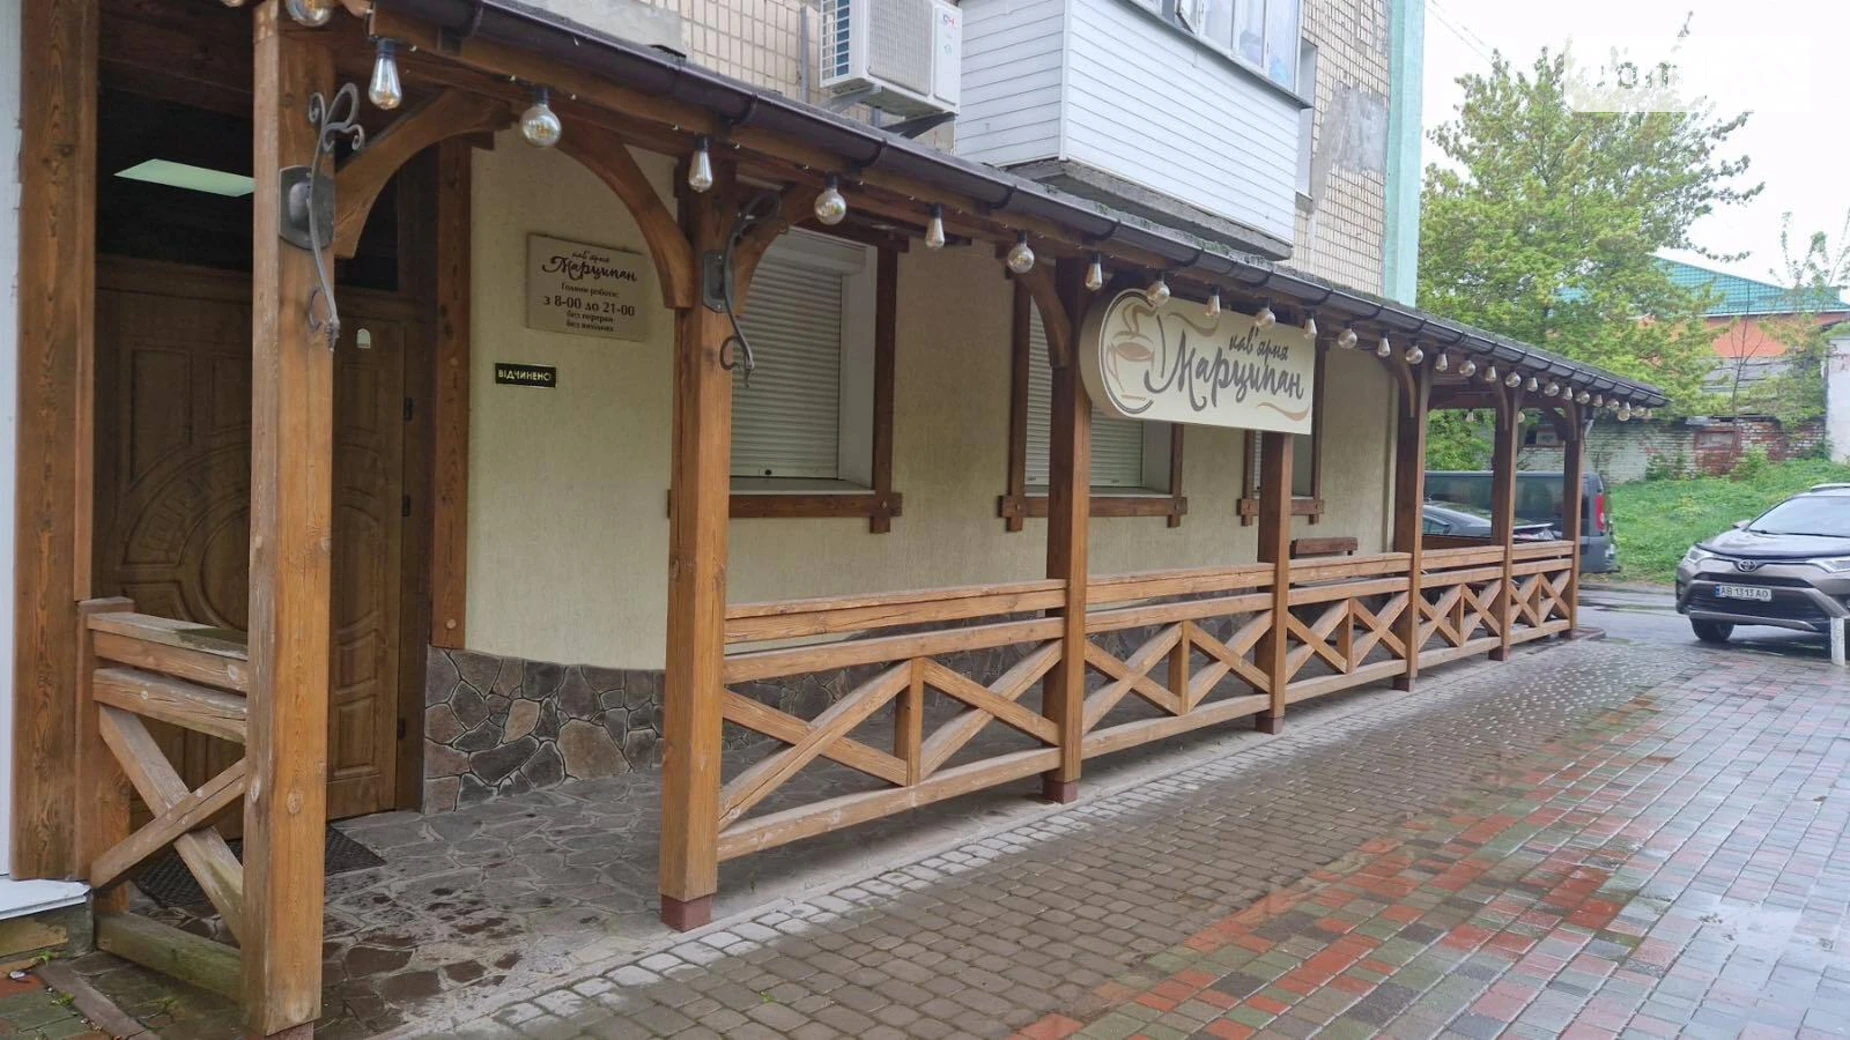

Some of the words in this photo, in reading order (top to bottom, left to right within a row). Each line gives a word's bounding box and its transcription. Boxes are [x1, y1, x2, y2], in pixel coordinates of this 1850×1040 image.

[542, 255, 638, 282] Марципан
[554, 295, 582, 309] 8-00
[584, 302, 599, 311] до
[602, 301, 635, 316] 21-00
[497, 369, 552, 381] ВІДЧИНЕНО
[1144, 329, 1304, 411] Марципан
